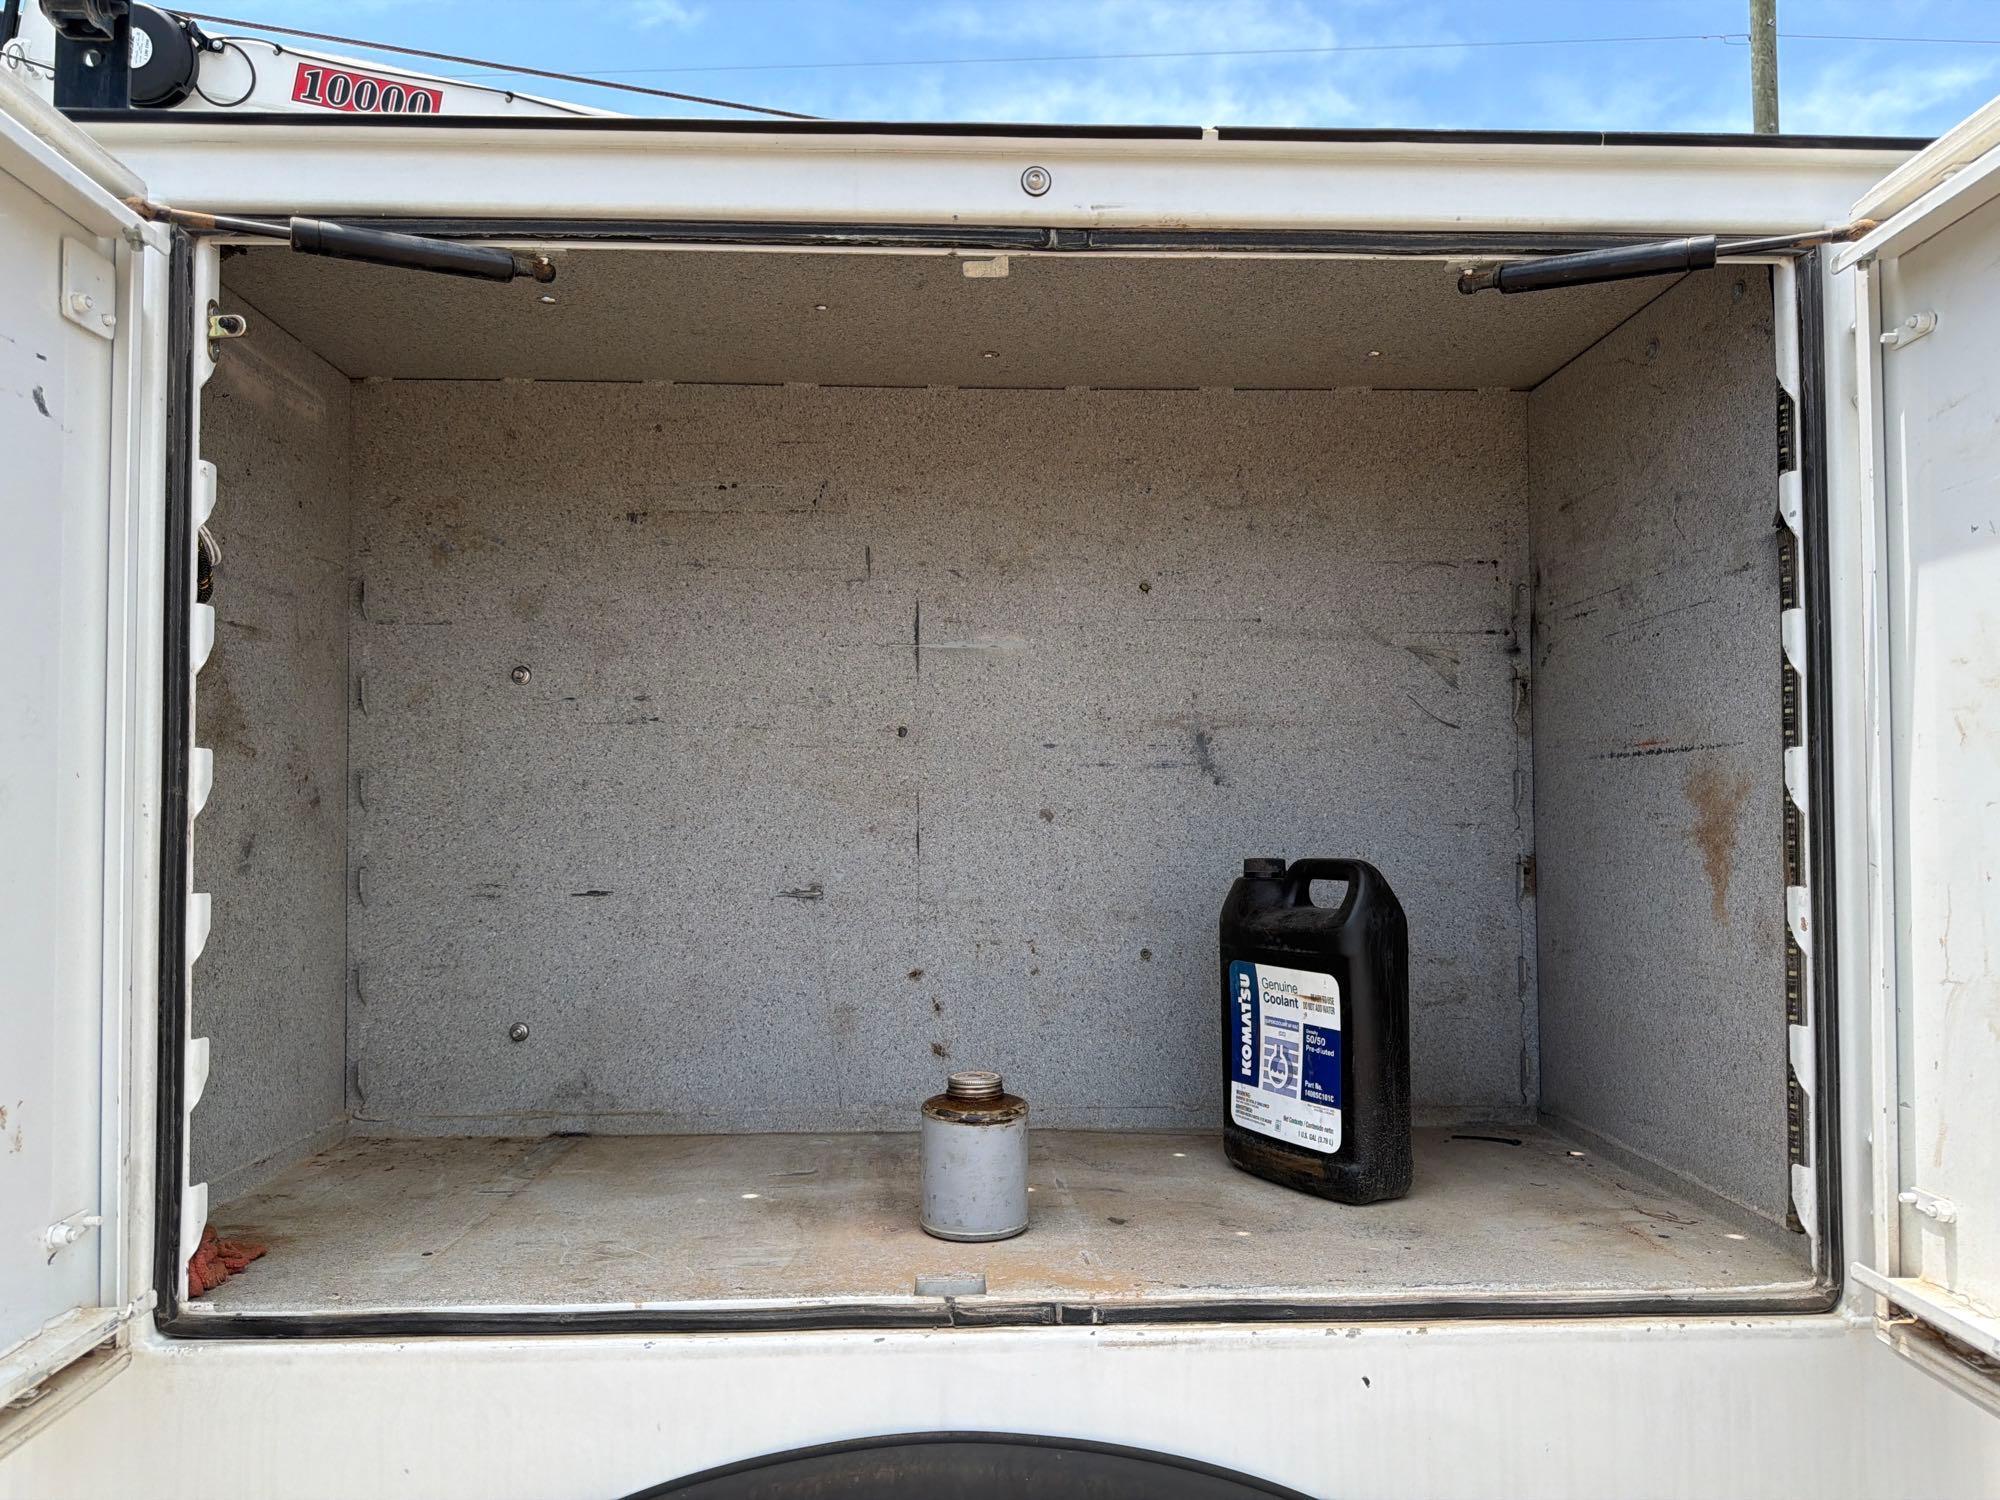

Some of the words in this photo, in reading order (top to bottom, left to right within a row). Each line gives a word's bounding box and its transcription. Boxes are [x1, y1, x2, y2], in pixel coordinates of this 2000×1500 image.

[300, 69, 433, 113] 10000
[1261, 977, 1298, 994] Genuine
[1263, 991, 1299, 1009] Coolant
[1238, 973, 1252, 1076] KOMATSU
[1305, 1034, 1326, 1047] 50/50
[1304, 1079, 1315, 1089] Part
